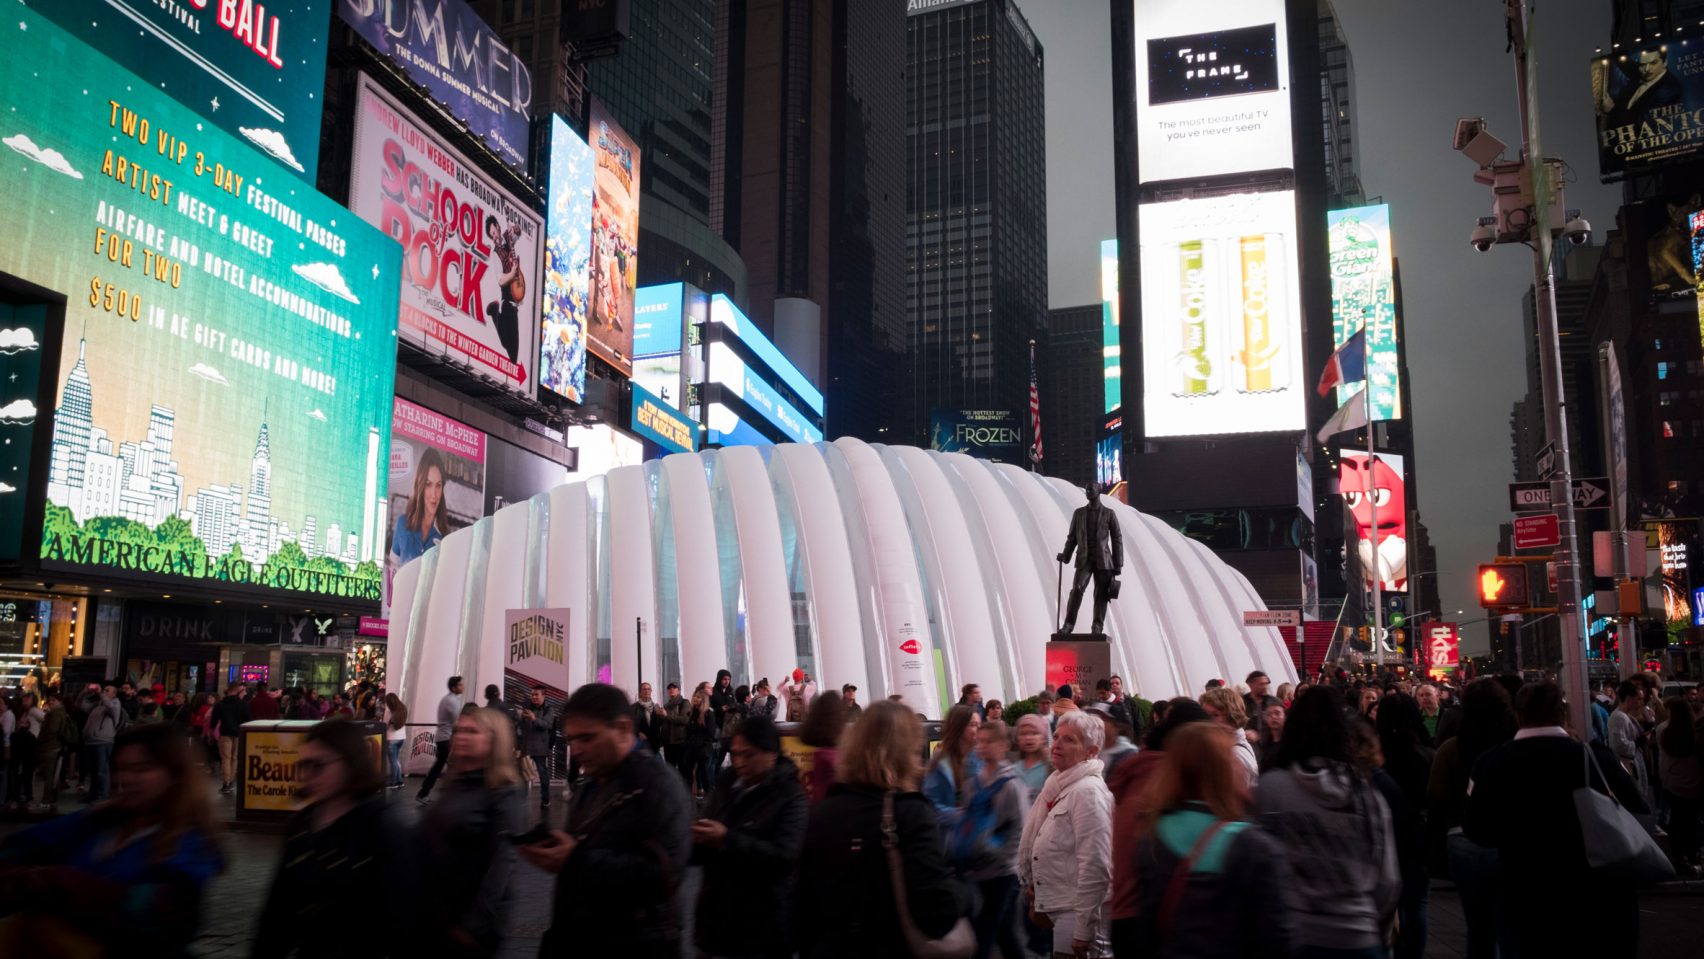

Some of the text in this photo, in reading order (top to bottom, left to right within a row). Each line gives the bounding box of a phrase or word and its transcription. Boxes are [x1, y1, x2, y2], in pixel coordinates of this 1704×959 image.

[216, 0, 283, 69] BALL
[1185, 52, 1217, 64] THE
[1186, 65, 1242, 80] FRAME
[396, 44, 501, 115] THE DONNA SUMMER MUSICAL
[1159, 109, 1268, 130] The most beautiful TV
[1650, 103, 1685, 119] THE
[1202, 125, 1233, 136] never
[1235, 123, 1261, 132] seen
[490, 128, 525, 163] ON BROADWAY
[1614, 142, 1635, 156] OF
[1639, 134, 1672, 149] THE
[109, 100, 346, 257] TWO VIP 3-DAY FESTIVAL PASSES
[401, 123, 426, 155] LLOYD
[427, 142, 455, 177] WEBBER
[456, 166, 470, 187] HAS
[471, 176, 505, 216] BROADWAY
[101, 150, 274, 258] ARTIST MEET & GREET
[382, 138, 492, 260] SCHOOL
[429, 222, 449, 257] of
[95, 227, 182, 289] FOR TWO
[96, 200, 165, 251] AIRFARE
[169, 235, 199, 267] AND
[204, 252, 245, 289] HOTEL
[249, 273, 352, 338] ACCOMMODATIONS
[1330, 248, 1378, 264] Green
[1331, 261, 1381, 278] Giant
[90, 276, 336, 397] $500 IN AE GIFT CARDS AND MORE!
[447, 328, 458, 346] THE
[458, 334, 479, 356] WINTER
[479, 343, 499, 367] GARDEN
[499, 355, 519, 378] THEATRE
[404, 422, 435, 441] STARRING
[436, 435, 446, 445] ON
[447, 438, 478, 457] BROADWAY
[445, 422, 479, 446] McPHEE
[956, 424, 1020, 447] FROZEN
[1524, 488, 1596, 502] ONE AY
[48, 531, 197, 578] AMERICAN
[204, 554, 272, 585] EAGLE
[276, 565, 382, 600] OUTFITTERS
[140, 615, 215, 640] DRINK
[511, 615, 564, 643] DESIGN NYC
[510, 635, 563, 665] PAVILION
[412, 731, 435, 749] DESIGN
[248, 784, 262, 796] The
[263, 785, 287, 797] Carole
